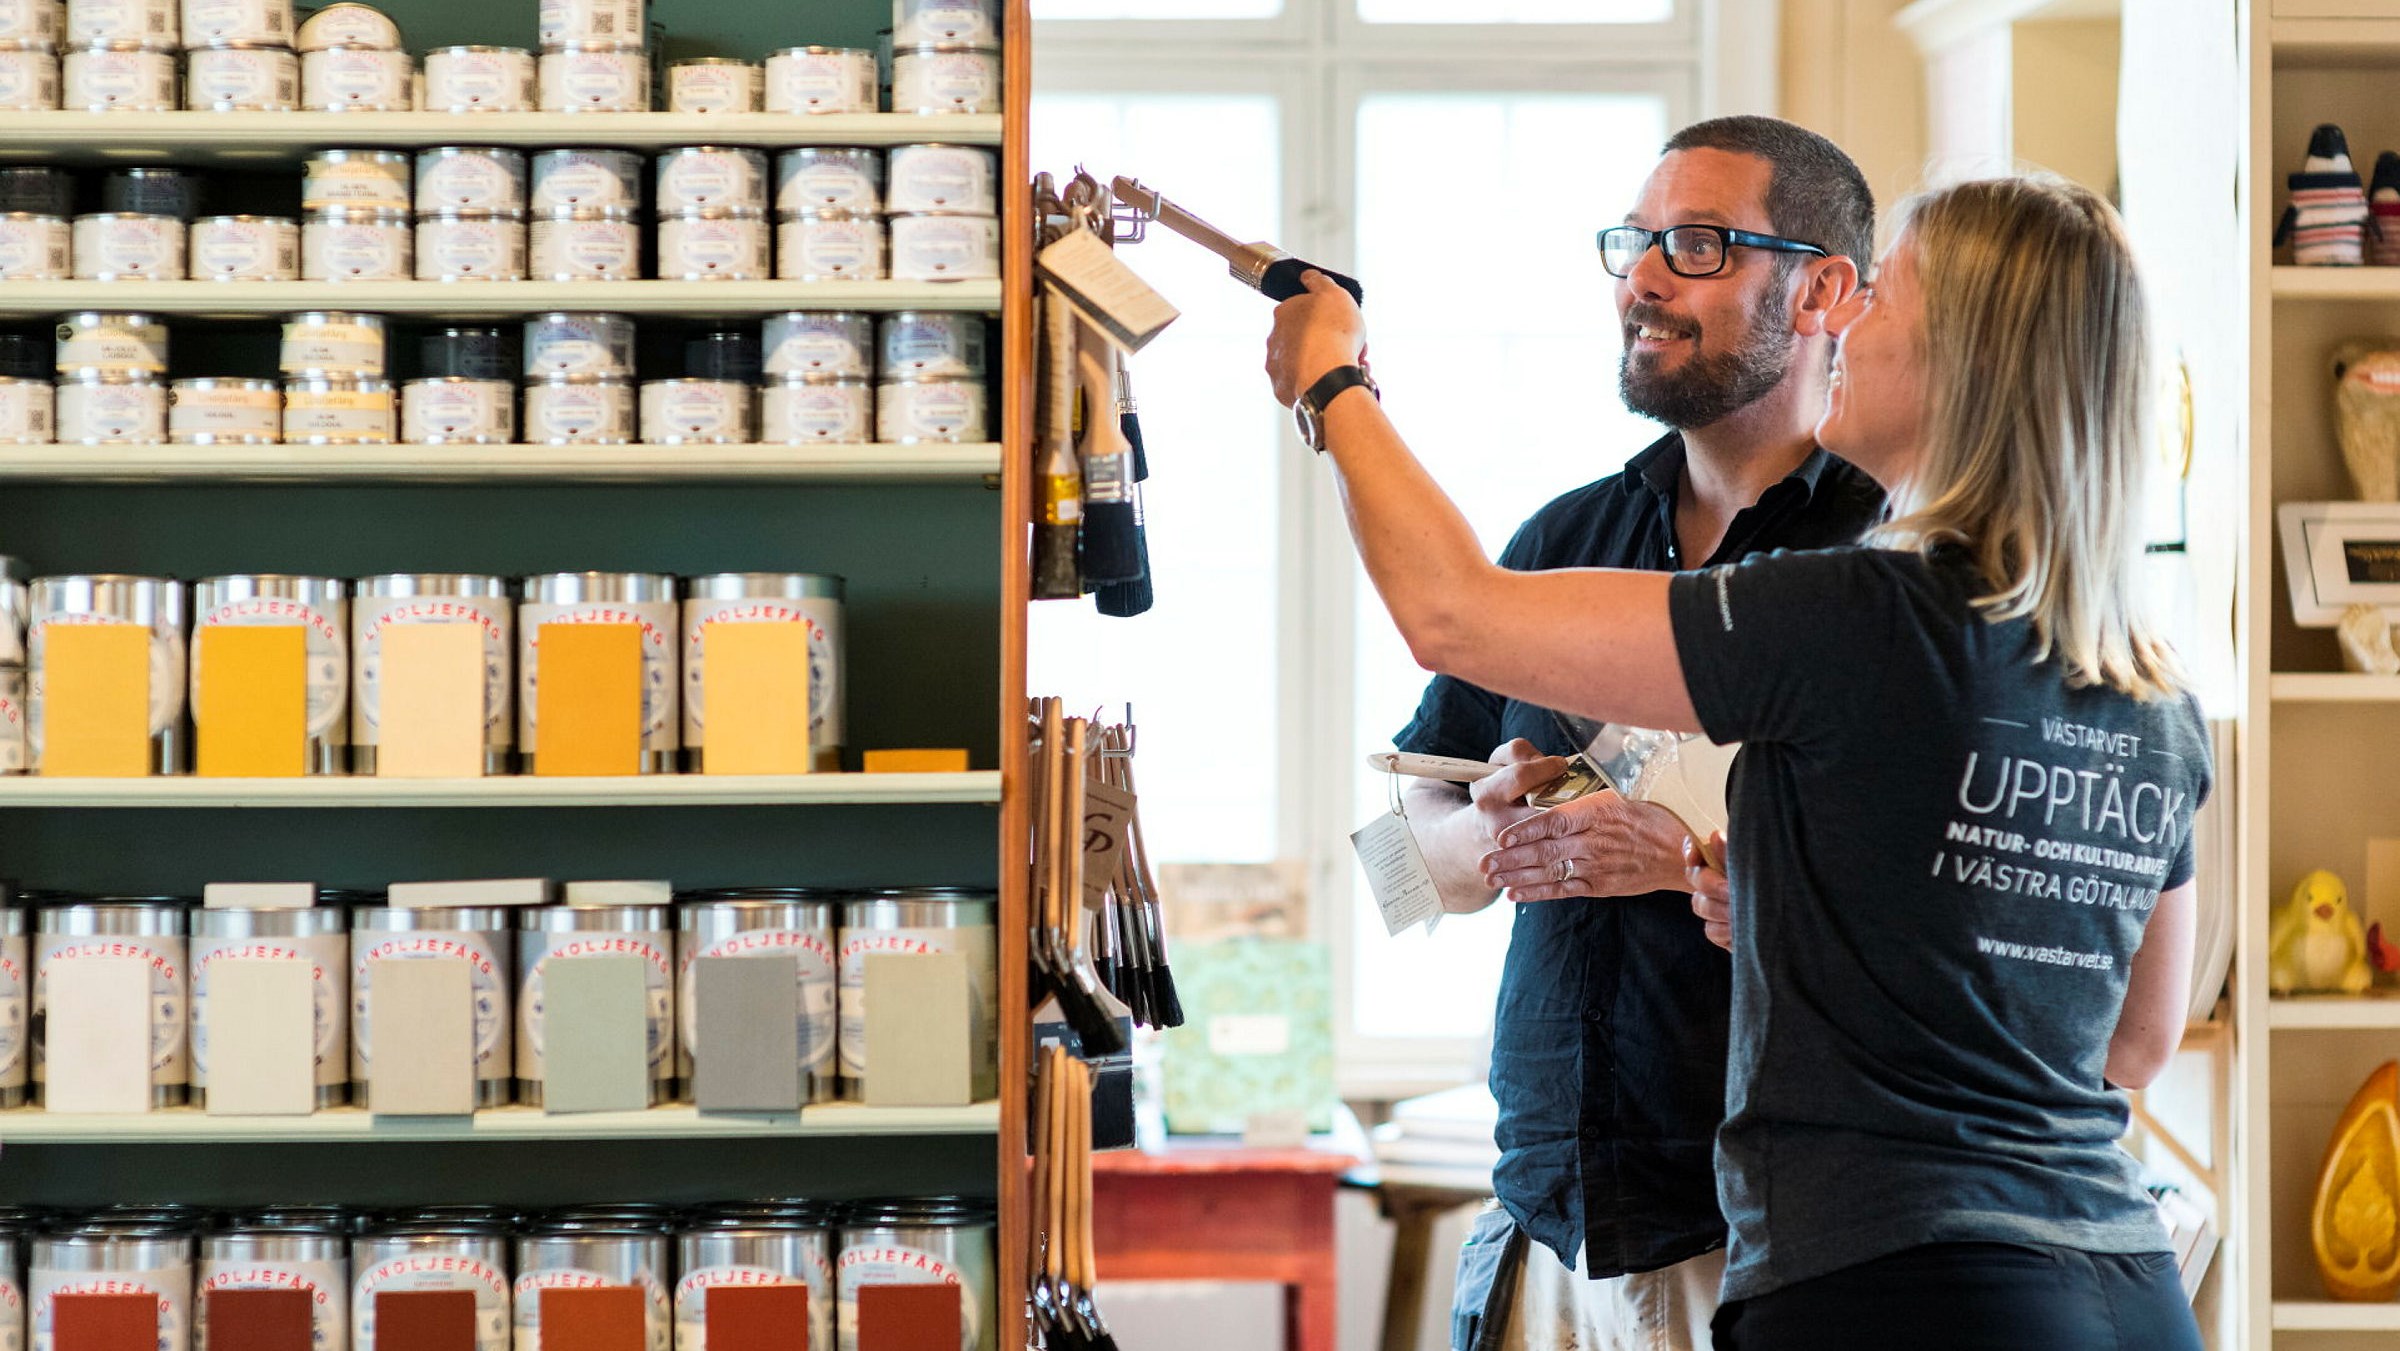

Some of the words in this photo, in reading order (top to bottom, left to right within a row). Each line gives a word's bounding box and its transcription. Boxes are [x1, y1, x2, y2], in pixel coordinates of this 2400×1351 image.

[2040, 716, 2141, 759] VÄSTARVET
[1959, 752, 2185, 847] UPPTÄCK
[1946, 821, 2031, 854] NATUR-
[2034, 838, 2071, 861] OCH
[1931, 852, 1945, 877] I
[1954, 855, 2061, 900] VÄSTRA
[2066, 875, 2158, 911] GÖTALAND
[1976, 936, 2113, 971] www.vastarvet.se
[361, 1257, 504, 1294] LINOLJEFÄRG
